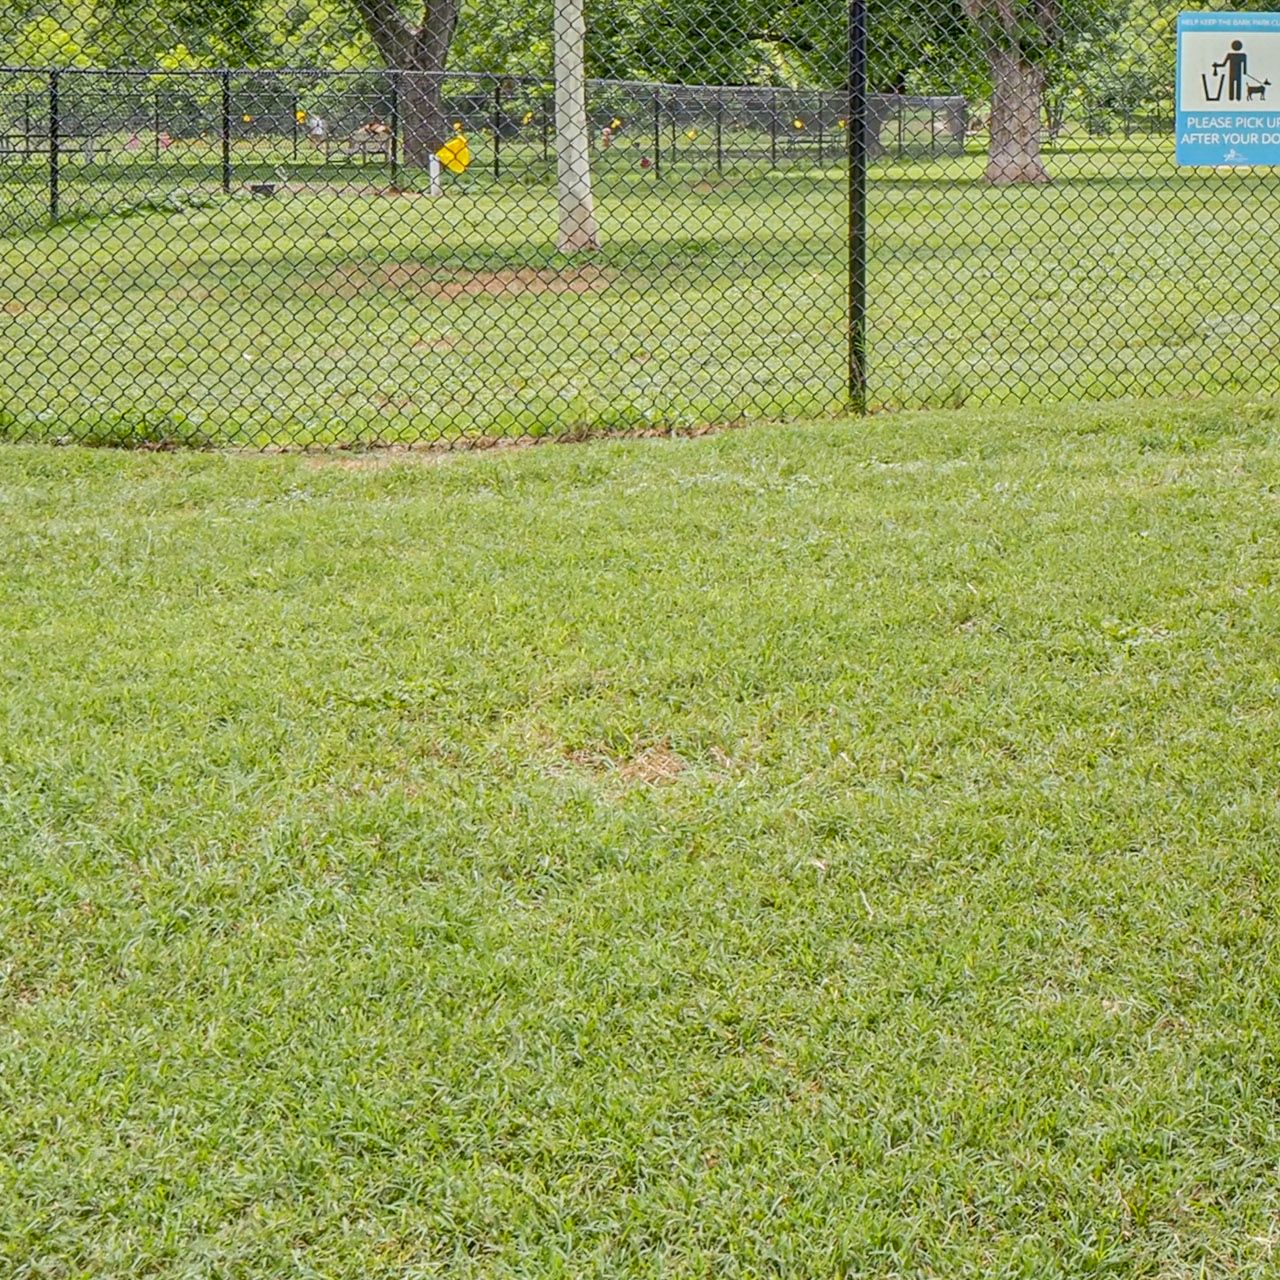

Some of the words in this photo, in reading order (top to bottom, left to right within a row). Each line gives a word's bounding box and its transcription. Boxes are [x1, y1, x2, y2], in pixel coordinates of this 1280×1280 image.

[1187, 117, 1232, 128] PLEASE
[1236, 117, 1263, 128] PICK
[1181, 133, 1220, 144] AFTER
[1222, 133, 1260, 144] YOUR
